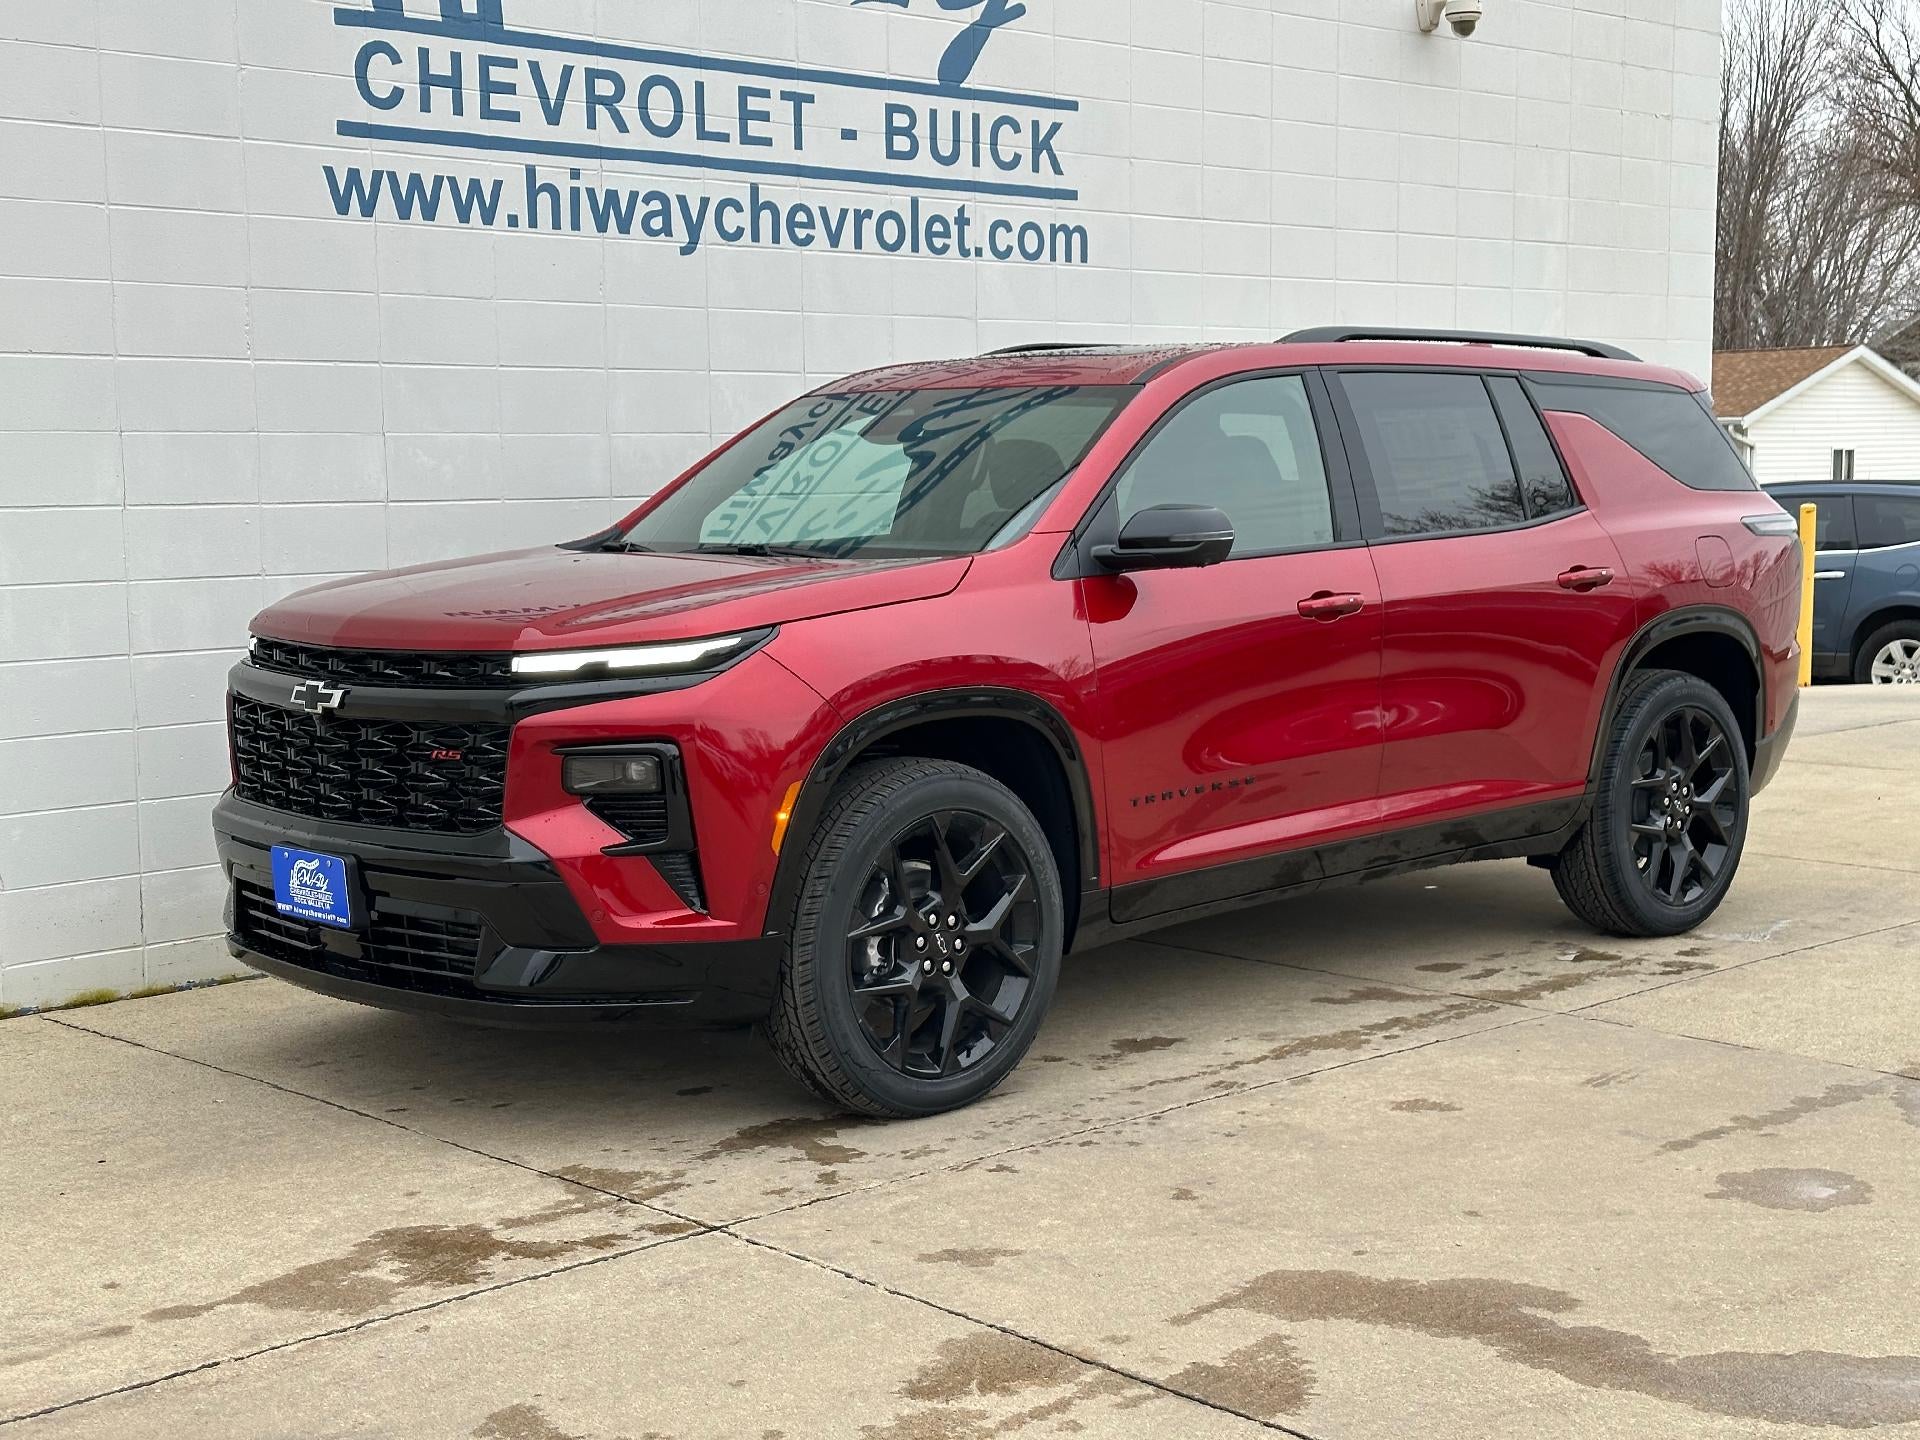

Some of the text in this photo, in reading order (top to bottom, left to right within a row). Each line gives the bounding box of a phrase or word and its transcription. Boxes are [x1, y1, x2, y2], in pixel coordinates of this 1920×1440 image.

[355, 40, 815, 151] CHEVROLET
[884, 103, 1066, 176] BUICK
[324, 164, 1088, 262] www.hiwaychevrolet.com
[431, 750, 462, 760] RS
[1129, 775, 1256, 807] TRAVERSE
